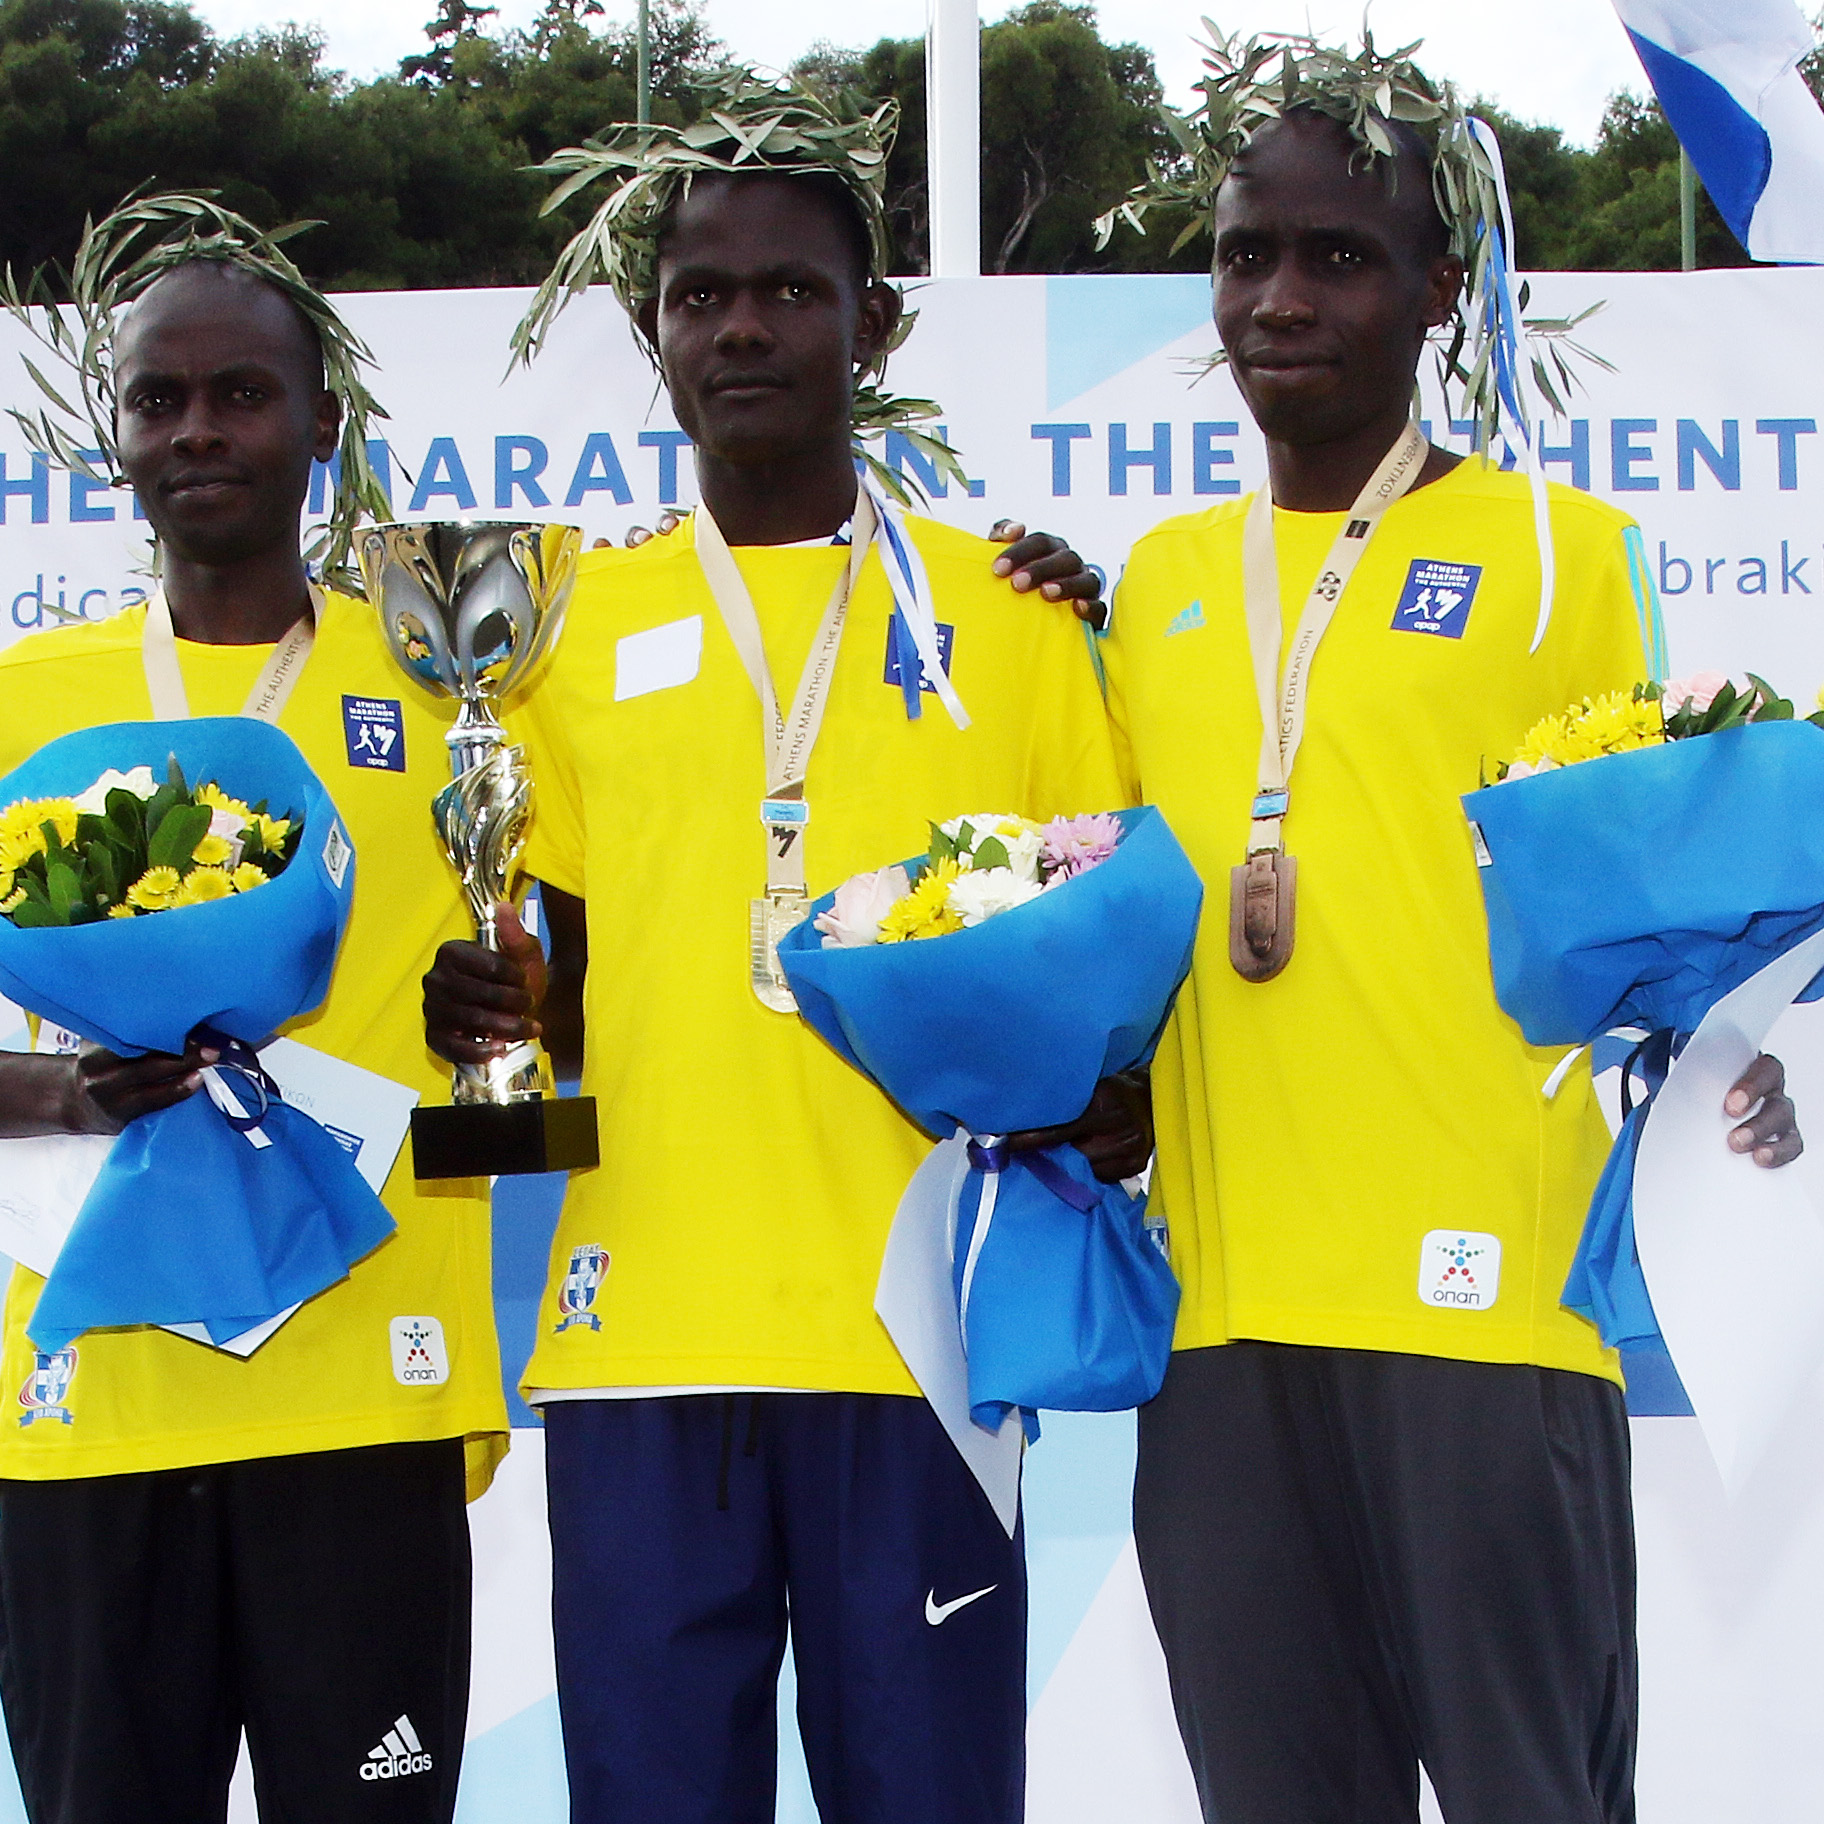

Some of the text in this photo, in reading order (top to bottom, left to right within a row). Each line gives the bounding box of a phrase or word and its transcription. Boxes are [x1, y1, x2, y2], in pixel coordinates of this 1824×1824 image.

[1031, 420, 1240, 496] THE
[1416, 571, 1471, 583] MARATHON
[257, 692, 275, 713] THE
[349, 707, 395, 717] MARATHON
[783, 732, 806, 780] ATHENS
[359, 1753, 433, 1781] adidas
